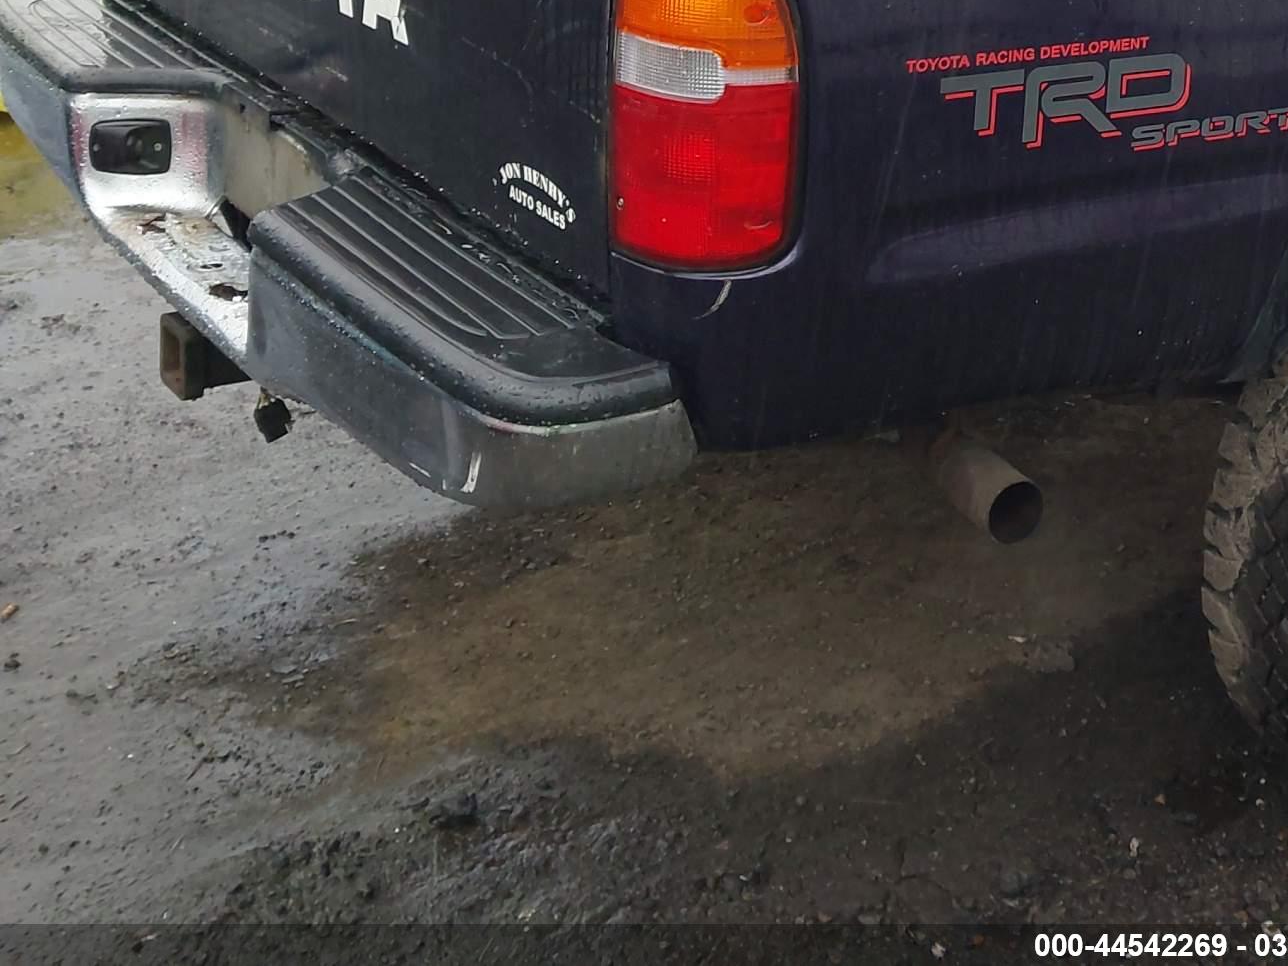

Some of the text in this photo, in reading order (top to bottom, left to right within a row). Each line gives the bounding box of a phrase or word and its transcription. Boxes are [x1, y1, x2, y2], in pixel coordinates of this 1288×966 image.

[906, 36, 1150, 73] TOYOTA RACING DEVELOPMENT
[940, 53, 1192, 148] TRD
[499, 162, 521, 184] JON
[509, 184, 566, 230] AUTO SALES
